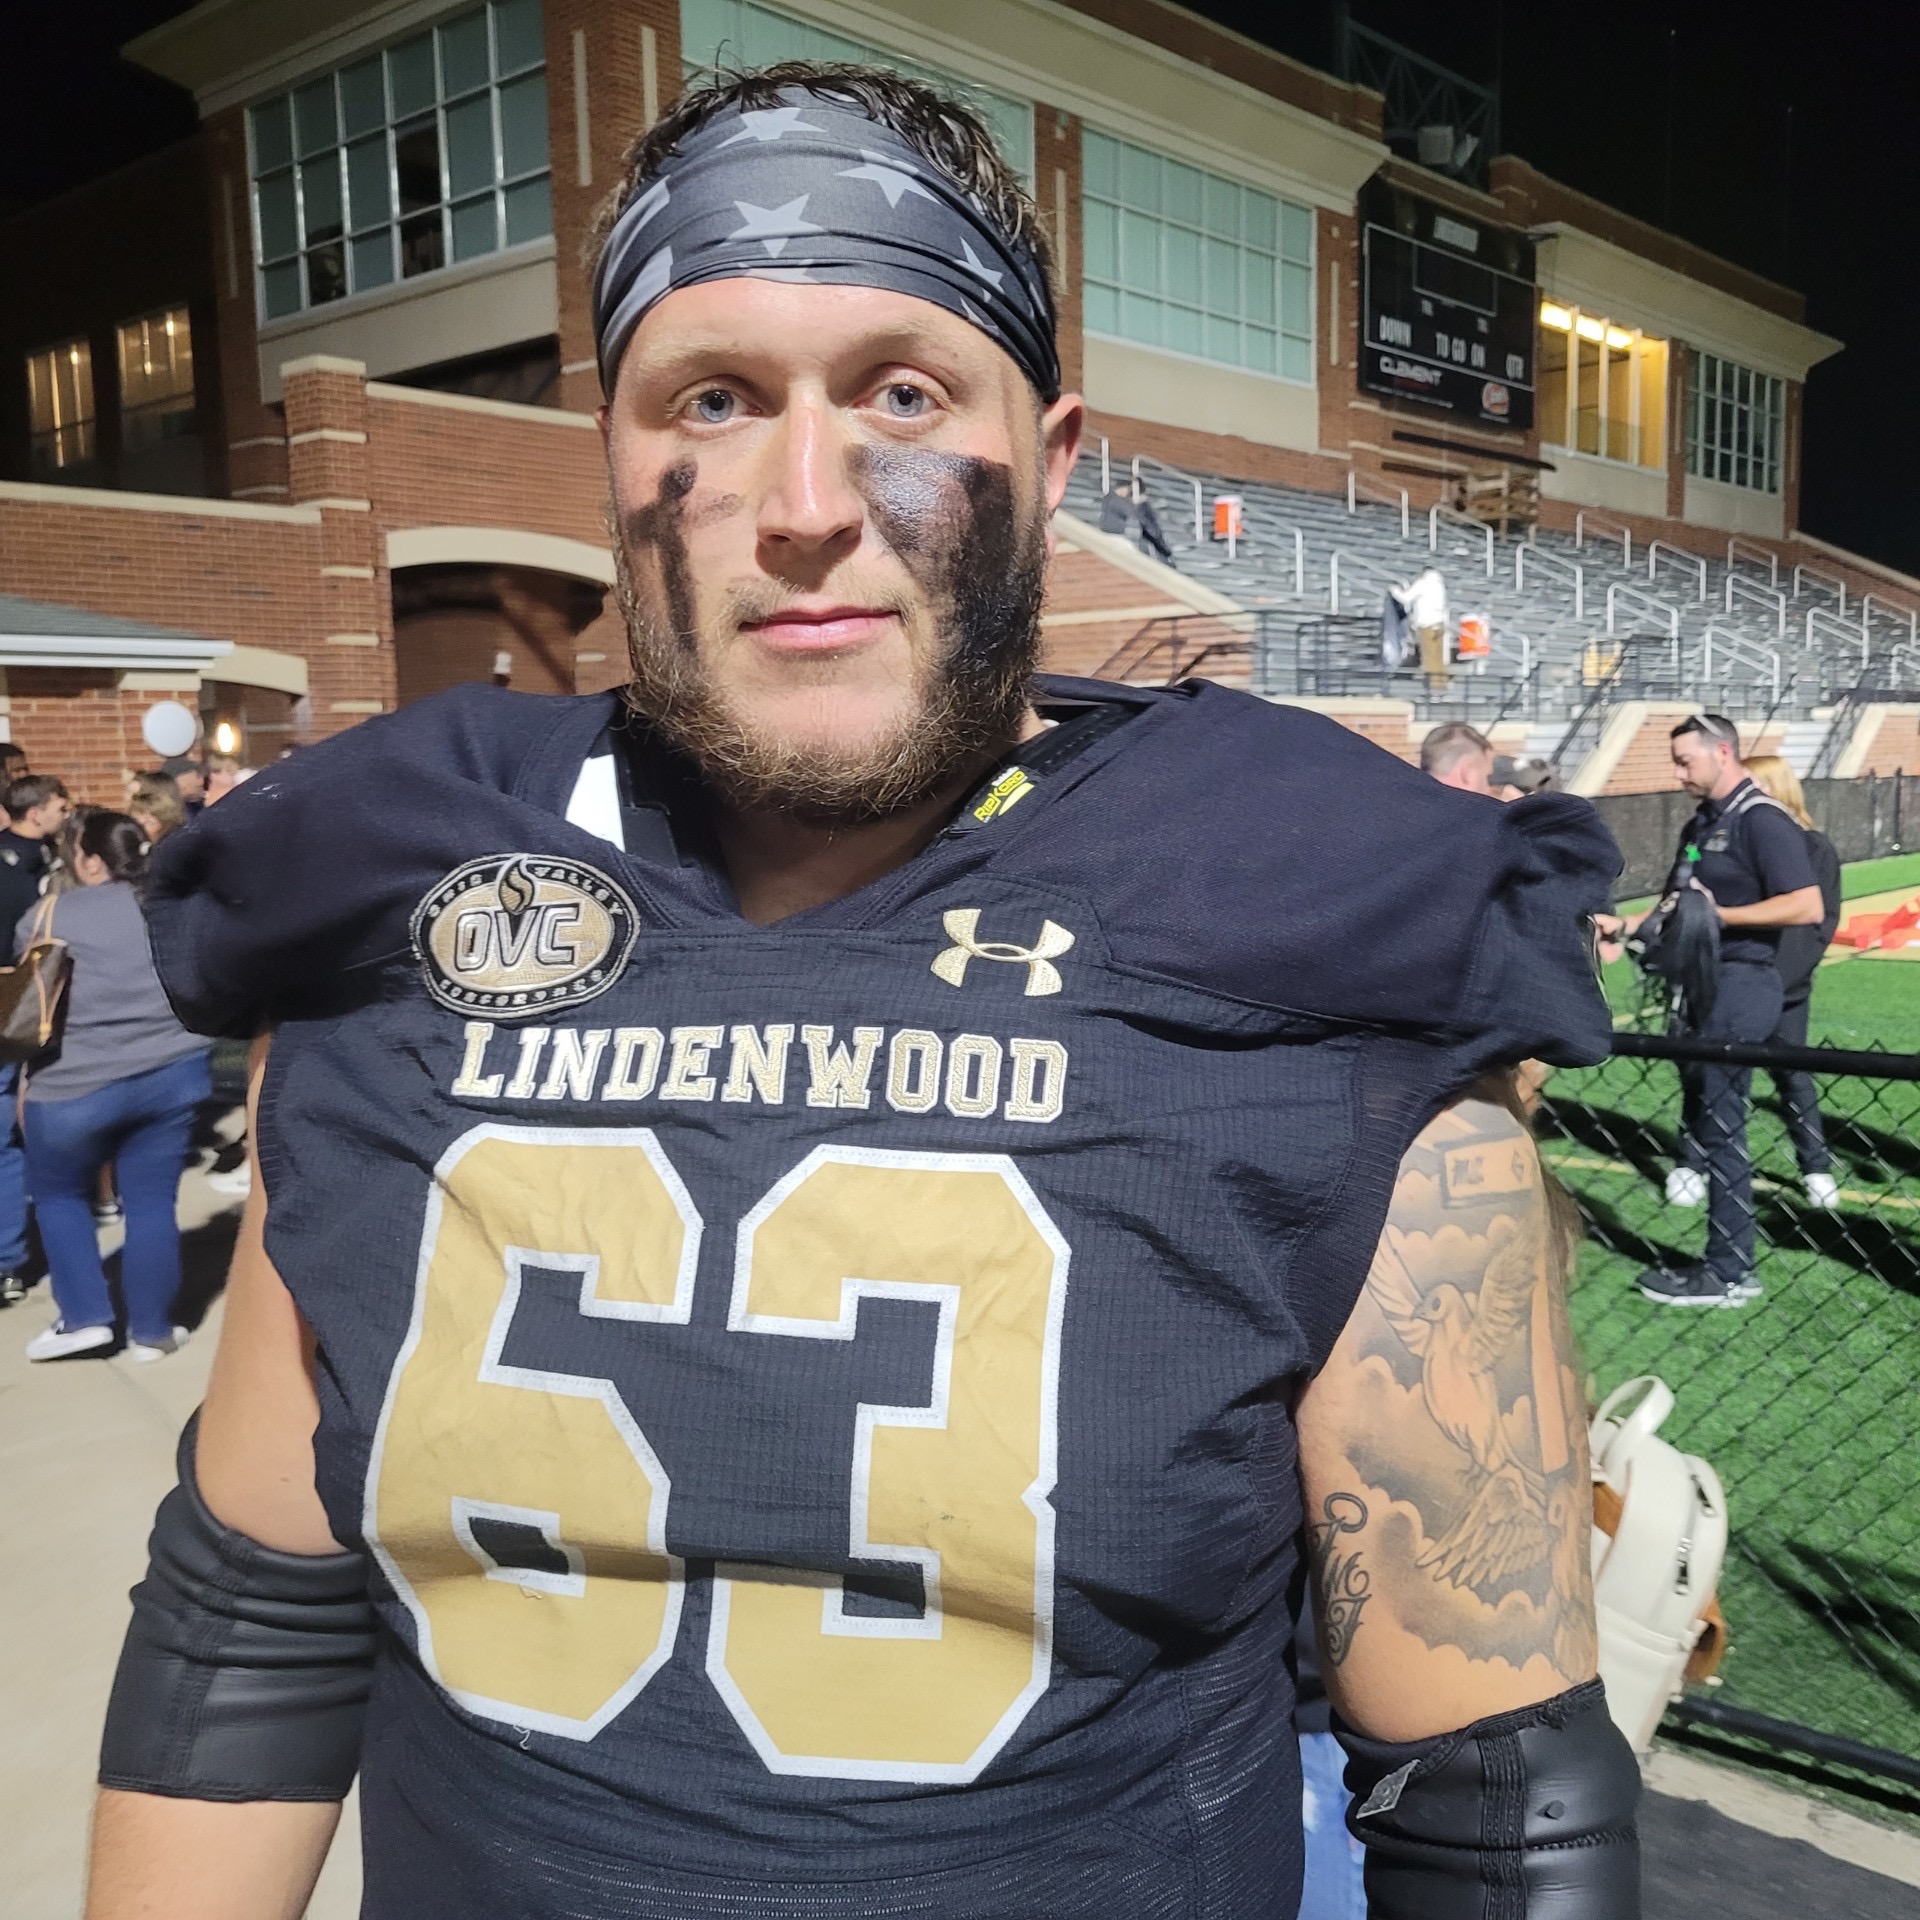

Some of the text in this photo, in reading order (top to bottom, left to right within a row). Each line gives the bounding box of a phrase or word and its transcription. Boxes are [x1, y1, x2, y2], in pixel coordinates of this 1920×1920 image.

[534, 866, 624, 916] VALLEY
[454, 902, 580, 973] OVC
[450, 1021, 1068, 1123] LINDENWOOD
[363, 1122, 1072, 1783] 63
